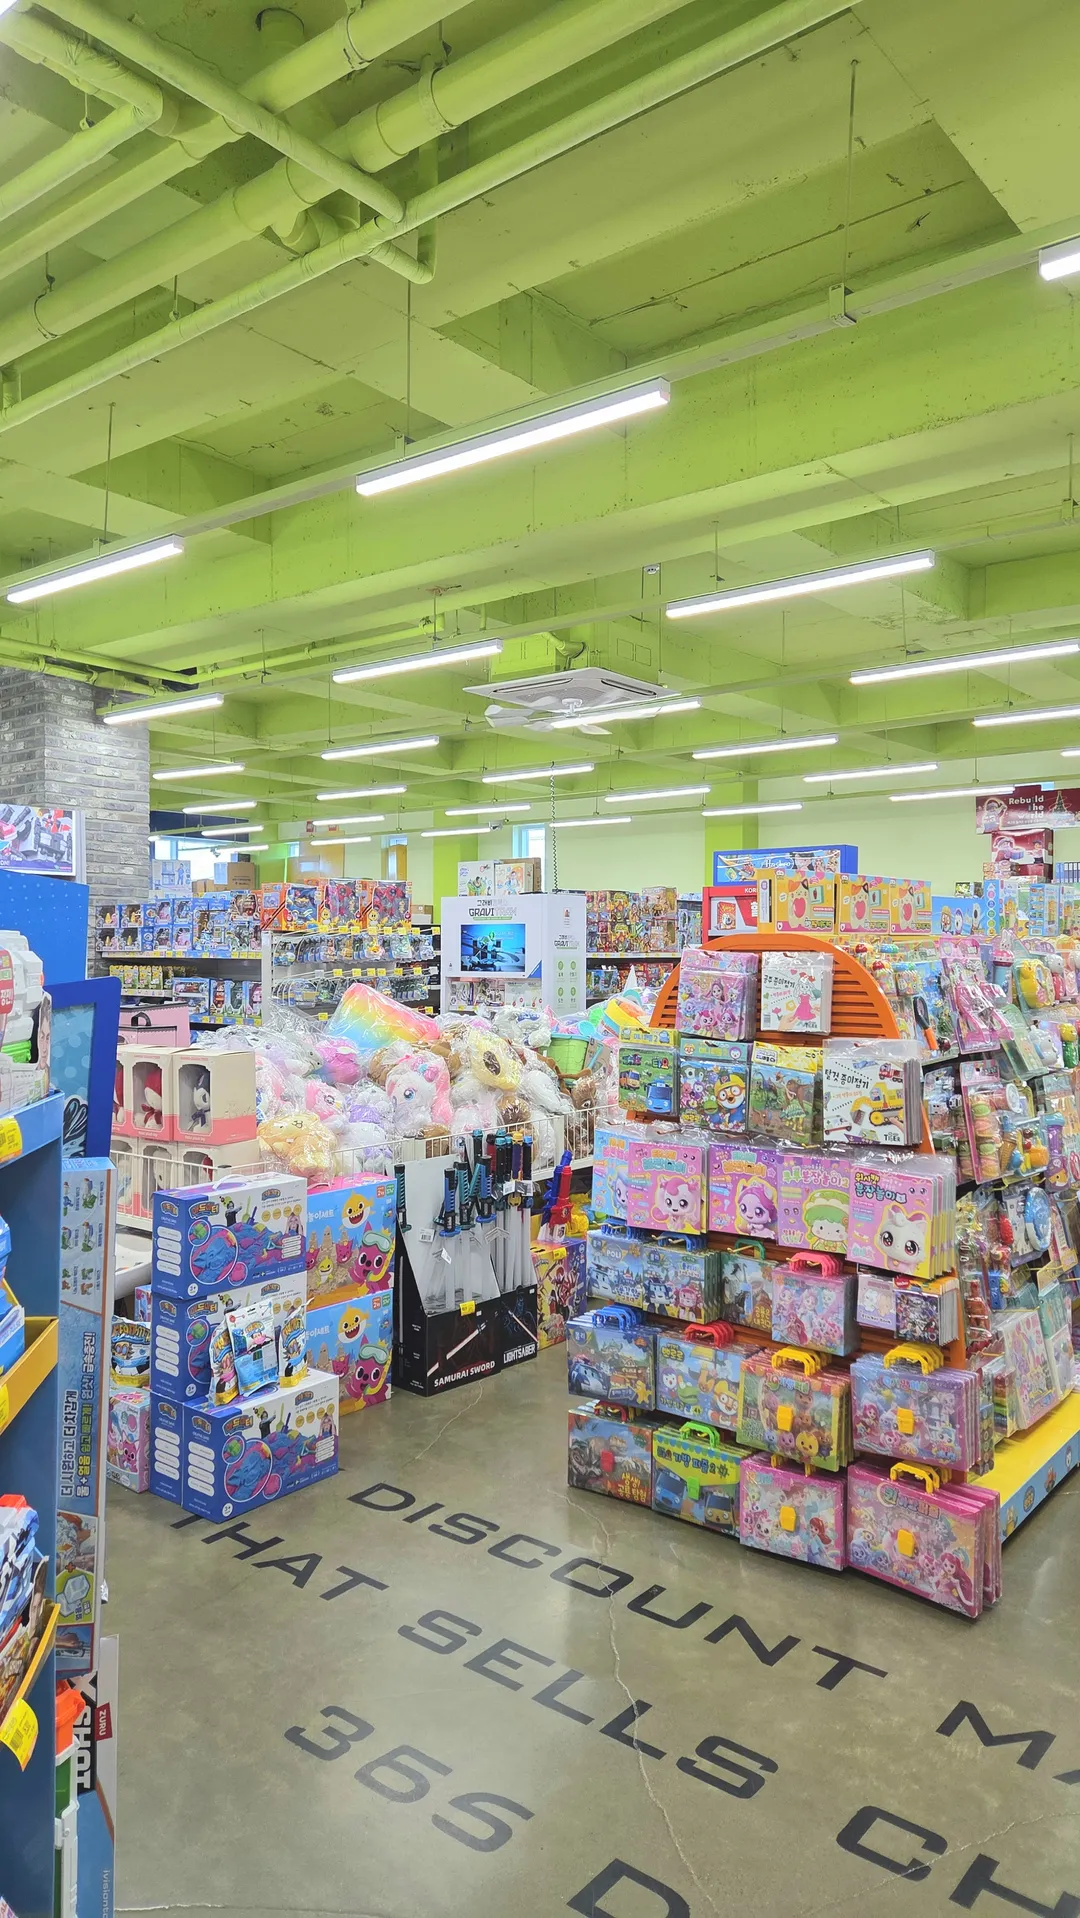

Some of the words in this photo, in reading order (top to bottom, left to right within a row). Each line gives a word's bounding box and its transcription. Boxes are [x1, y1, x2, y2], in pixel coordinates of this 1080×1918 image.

[824, 1069, 839, 1082] 탈것
[841, 1073, 869, 1089] 종이접기
[606, 1249, 621, 1259] POLI
[503, 1343, 536, 1364] LIGHTSABER
[434, 1368, 469, 1387] SAMURAI
[470, 1359, 496, 1376] SWORD
[65, 1391, 78, 1424] 차갑게
[63, 1426, 77, 1437] 더
[61, 1439, 75, 1483] 시원하고
[673, 1452, 691, 1467] 가방
[692, 1458, 709, 1474] 퍼즐
[709, 1463, 716, 1474] 2
[61, 1485, 74, 1497] 더
[346, 1482, 888, 1690] DISCOUNT
[936, 1700, 1080, 1785] M
[397, 1609, 778, 1799] SELLS
[98, 1708, 107, 1737] ZURU
